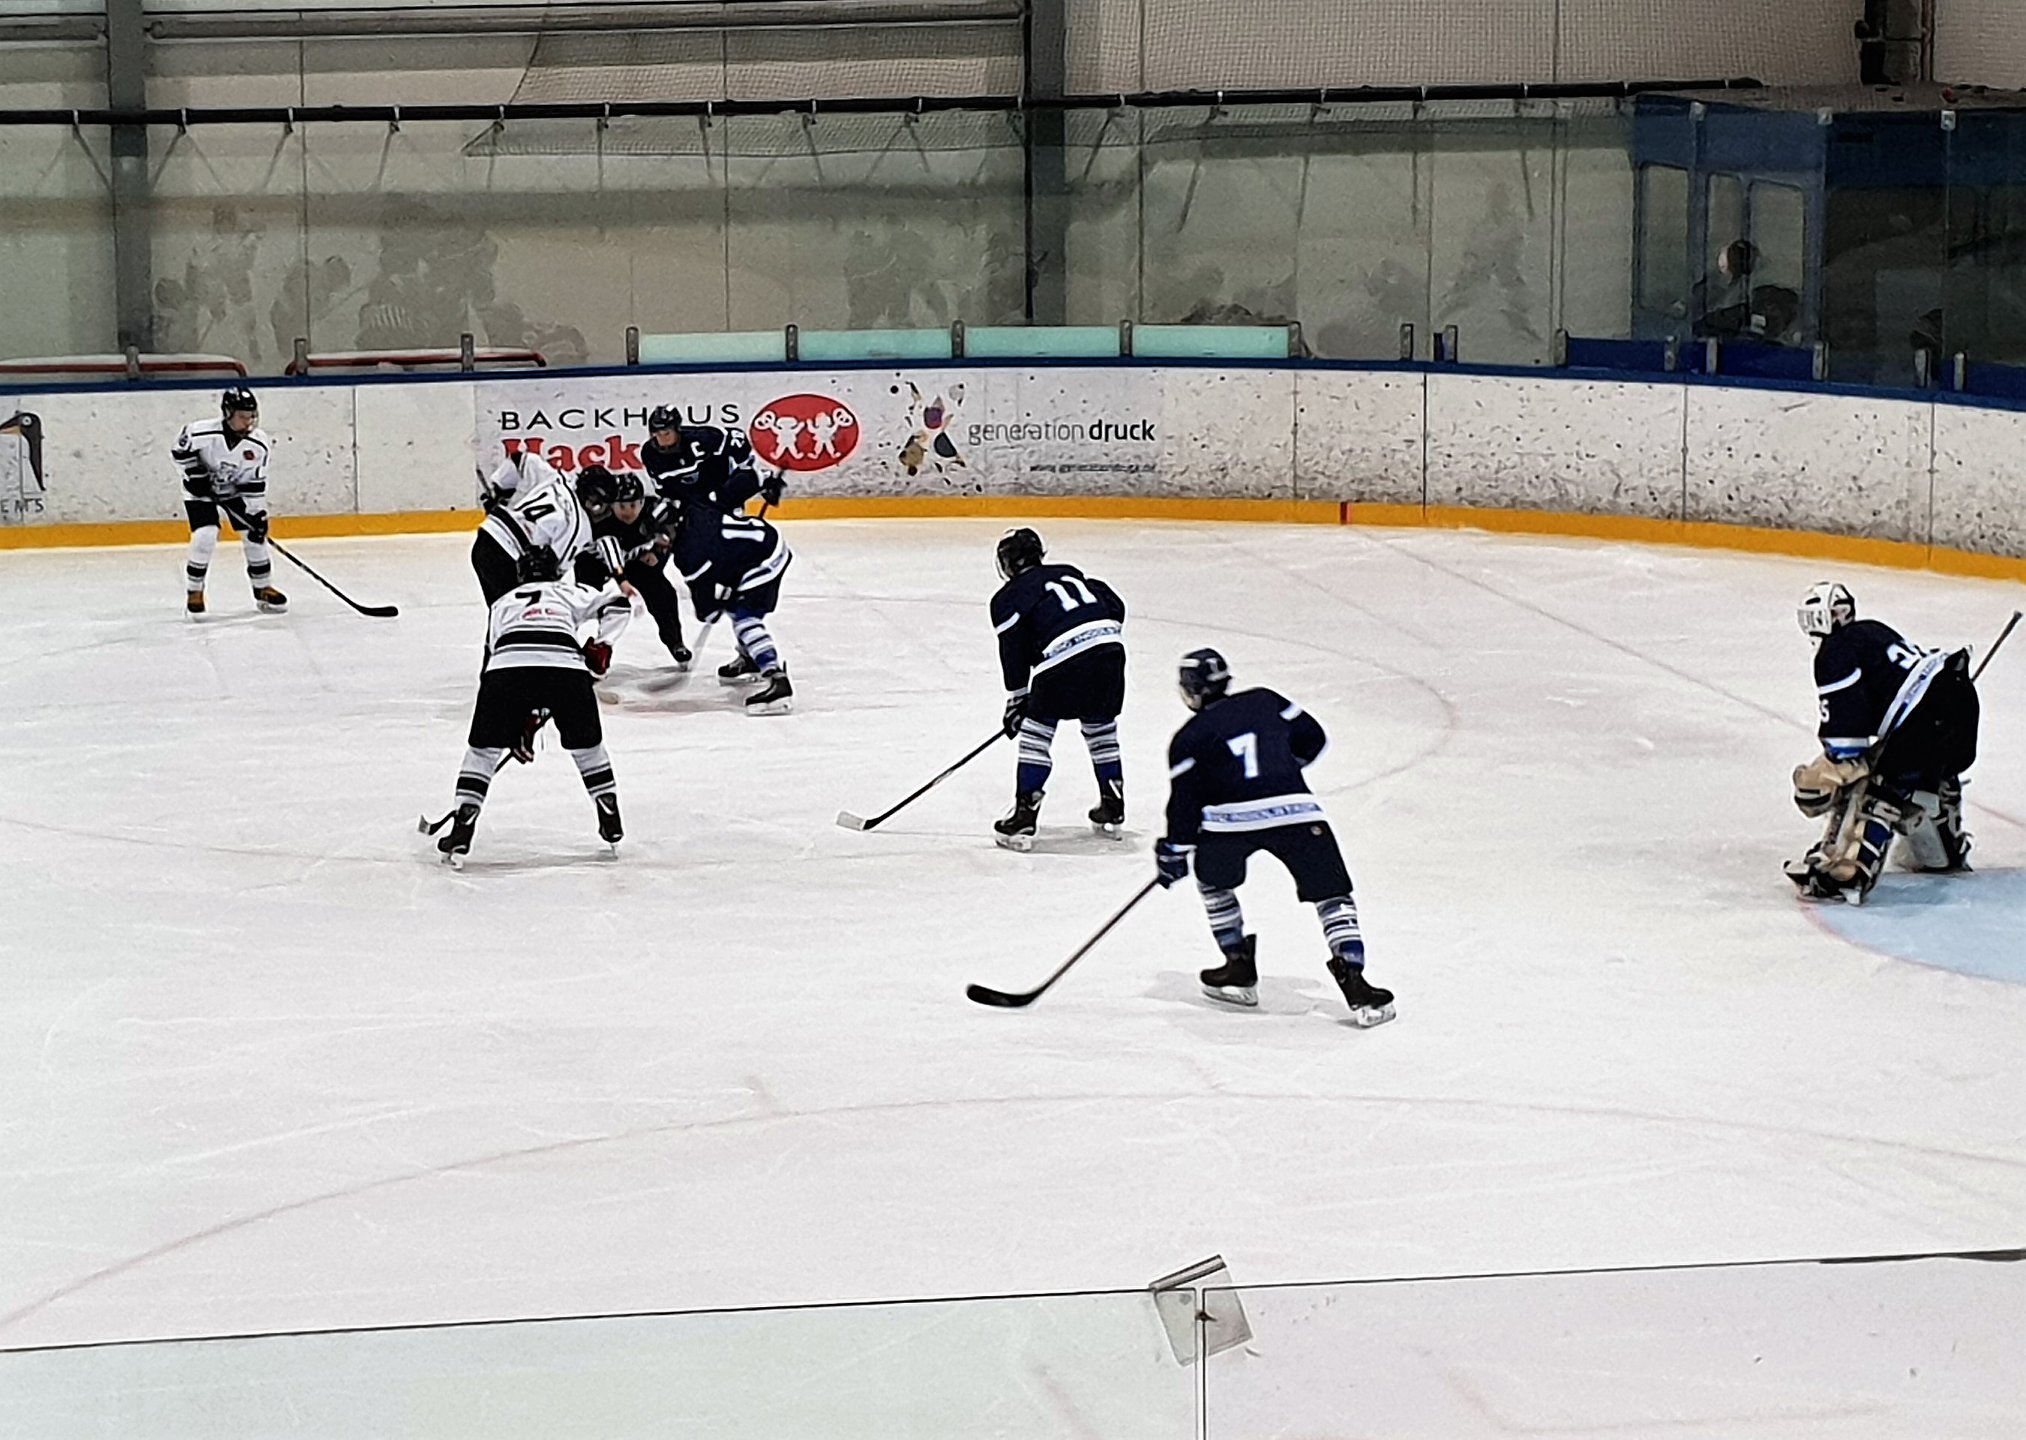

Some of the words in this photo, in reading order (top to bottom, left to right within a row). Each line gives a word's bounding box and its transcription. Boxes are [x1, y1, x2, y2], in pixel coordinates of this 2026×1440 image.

[501, 403, 740, 430] BACKHUS
[968, 421, 1084, 446] generation
[1088, 418, 1155, 441] druck
[1044, 576, 1098, 612] 11
[1226, 732, 1260, 780] 7
